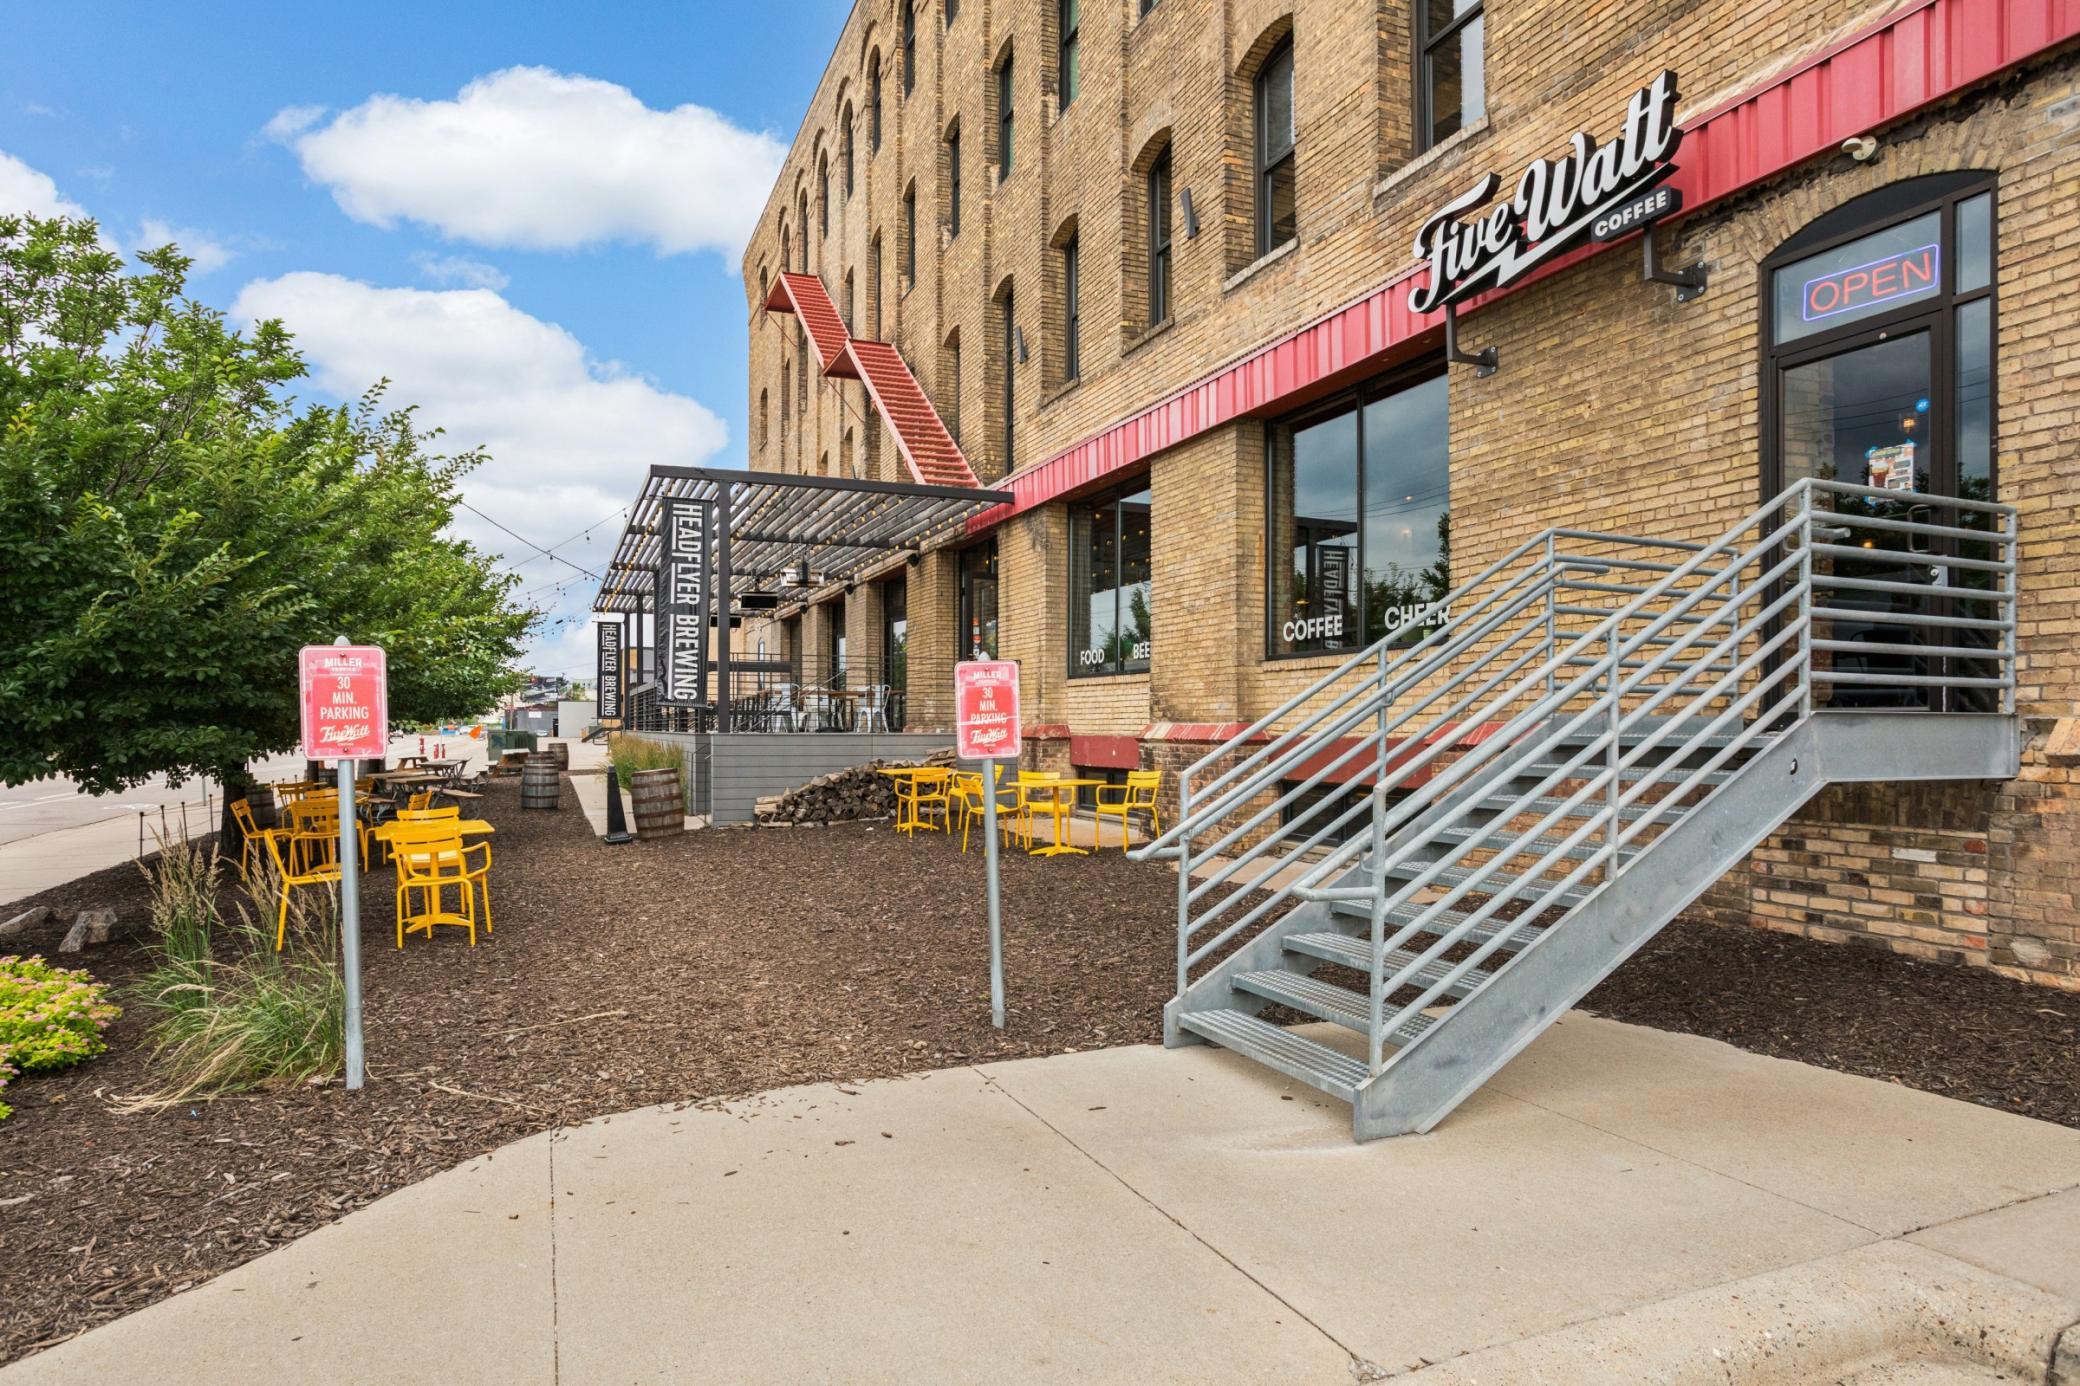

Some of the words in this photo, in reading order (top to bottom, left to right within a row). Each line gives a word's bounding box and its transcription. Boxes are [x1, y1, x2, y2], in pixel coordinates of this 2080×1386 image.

[1408, 172, 1513, 313] Five
[1514, 69, 1673, 241] Watt
[1594, 190, 1667, 237] COFFEE
[1809, 252, 1932, 312] OPEN
[672, 503, 703, 605] HEADFLYER
[1283, 615, 1343, 642] COFFEE
[602, 624, 617, 672] HEADFLYER
[324, 657, 362, 668] MILLER
[673, 614, 700, 700] BREWING
[1080, 649, 1105, 665] FOOD
[337, 676, 351, 690] 30
[973, 671, 1001, 680] MILLER
[332, 691, 357, 705] MIN.
[604, 675, 617, 716] BREWING
[982, 687, 993, 699] 30
[320, 706, 369, 720] PARKING
[979, 700, 998, 712] MIN.
[970, 712, 1008, 725] PARKING
